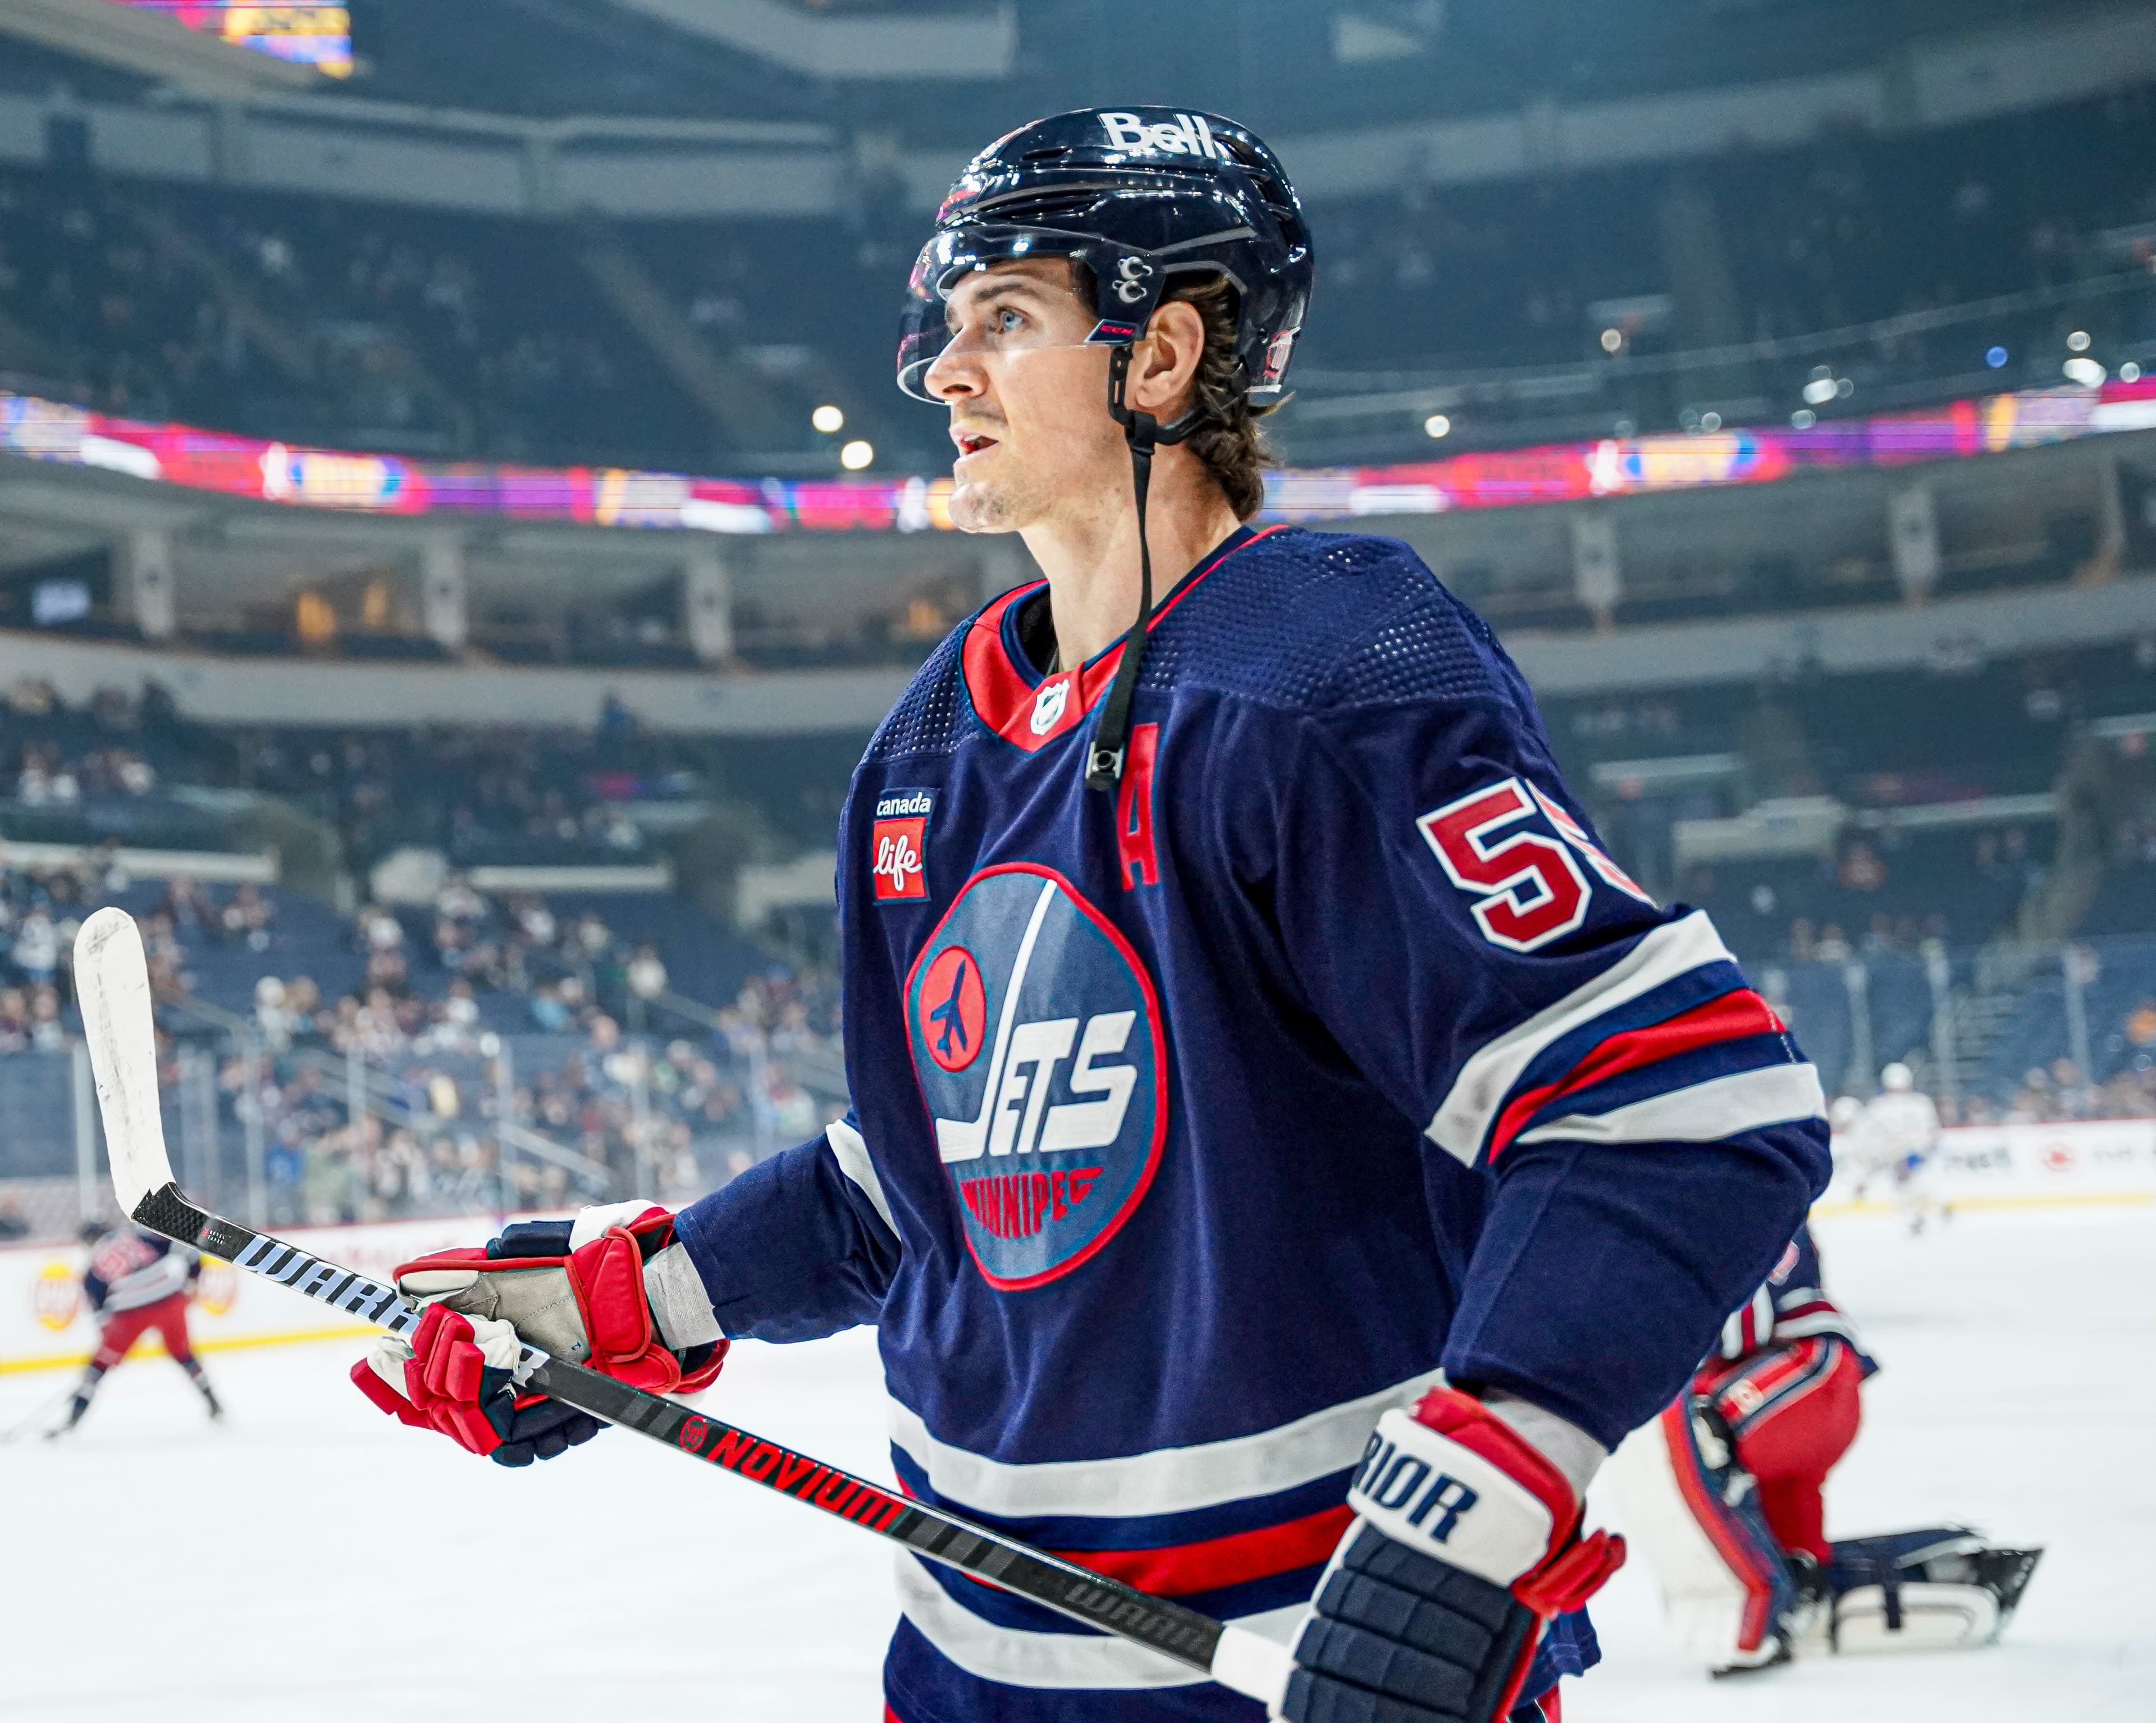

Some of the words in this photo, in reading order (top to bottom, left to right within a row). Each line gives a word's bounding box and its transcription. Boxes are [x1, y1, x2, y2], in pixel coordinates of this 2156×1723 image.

[1097, 112, 1217, 159] Bell
[876, 792, 931, 816] canada
[1117, 722, 1160, 891] A
[873, 835, 923, 891] life
[935, 879, 1138, 1164] JETS
[960, 1166, 1104, 1239] WINNIPEG
[705, 1428, 908, 1533] NOVIUM
